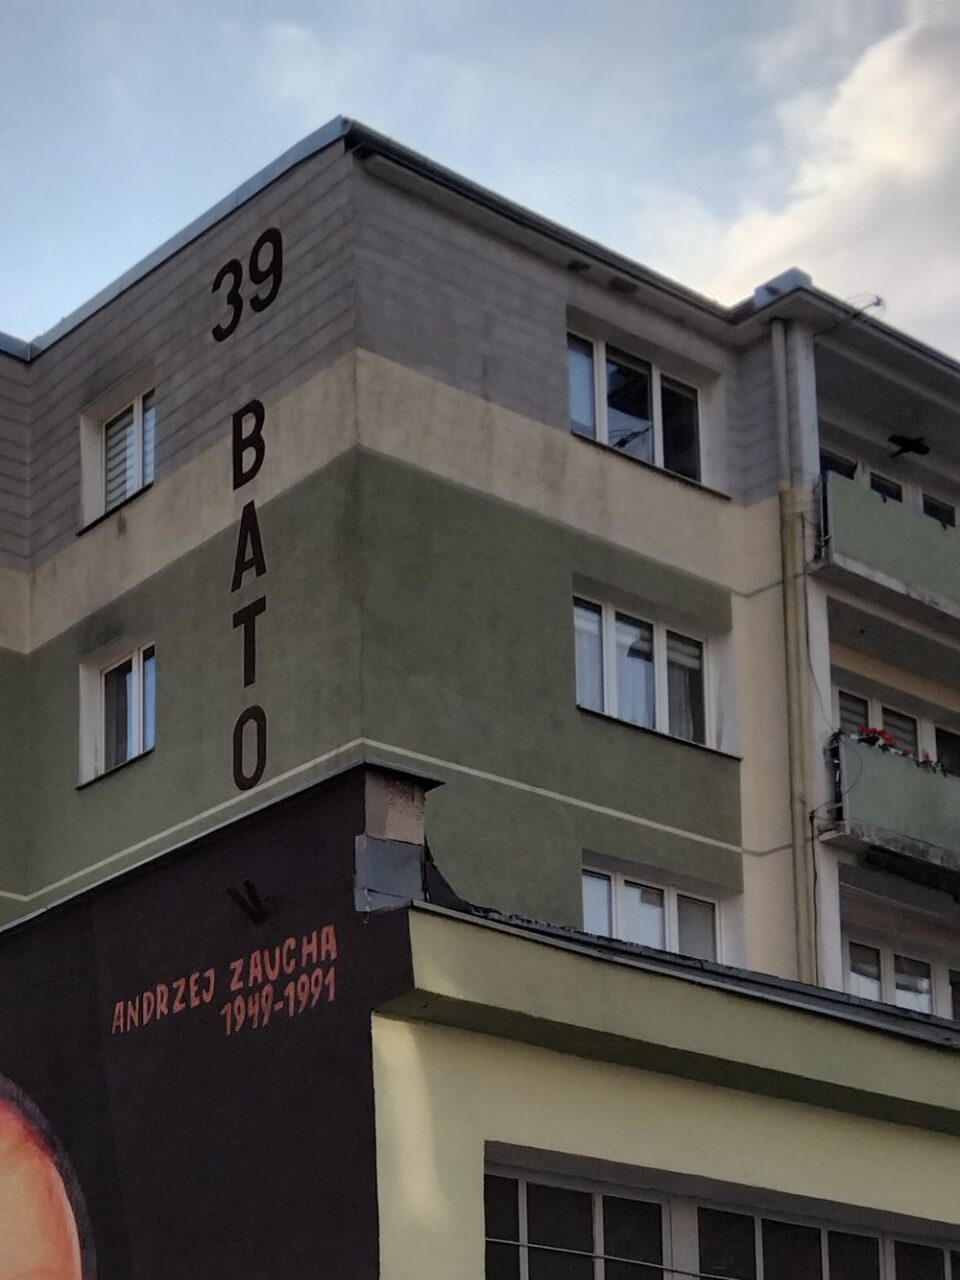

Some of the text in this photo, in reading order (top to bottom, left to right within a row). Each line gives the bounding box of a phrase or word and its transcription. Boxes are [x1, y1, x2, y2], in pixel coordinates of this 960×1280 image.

[211, 227, 283, 342] 39
[112, 924, 338, 1035] ANDRZEJ ZAUCHA
[220, 966, 336, 1035] 1949-1991
